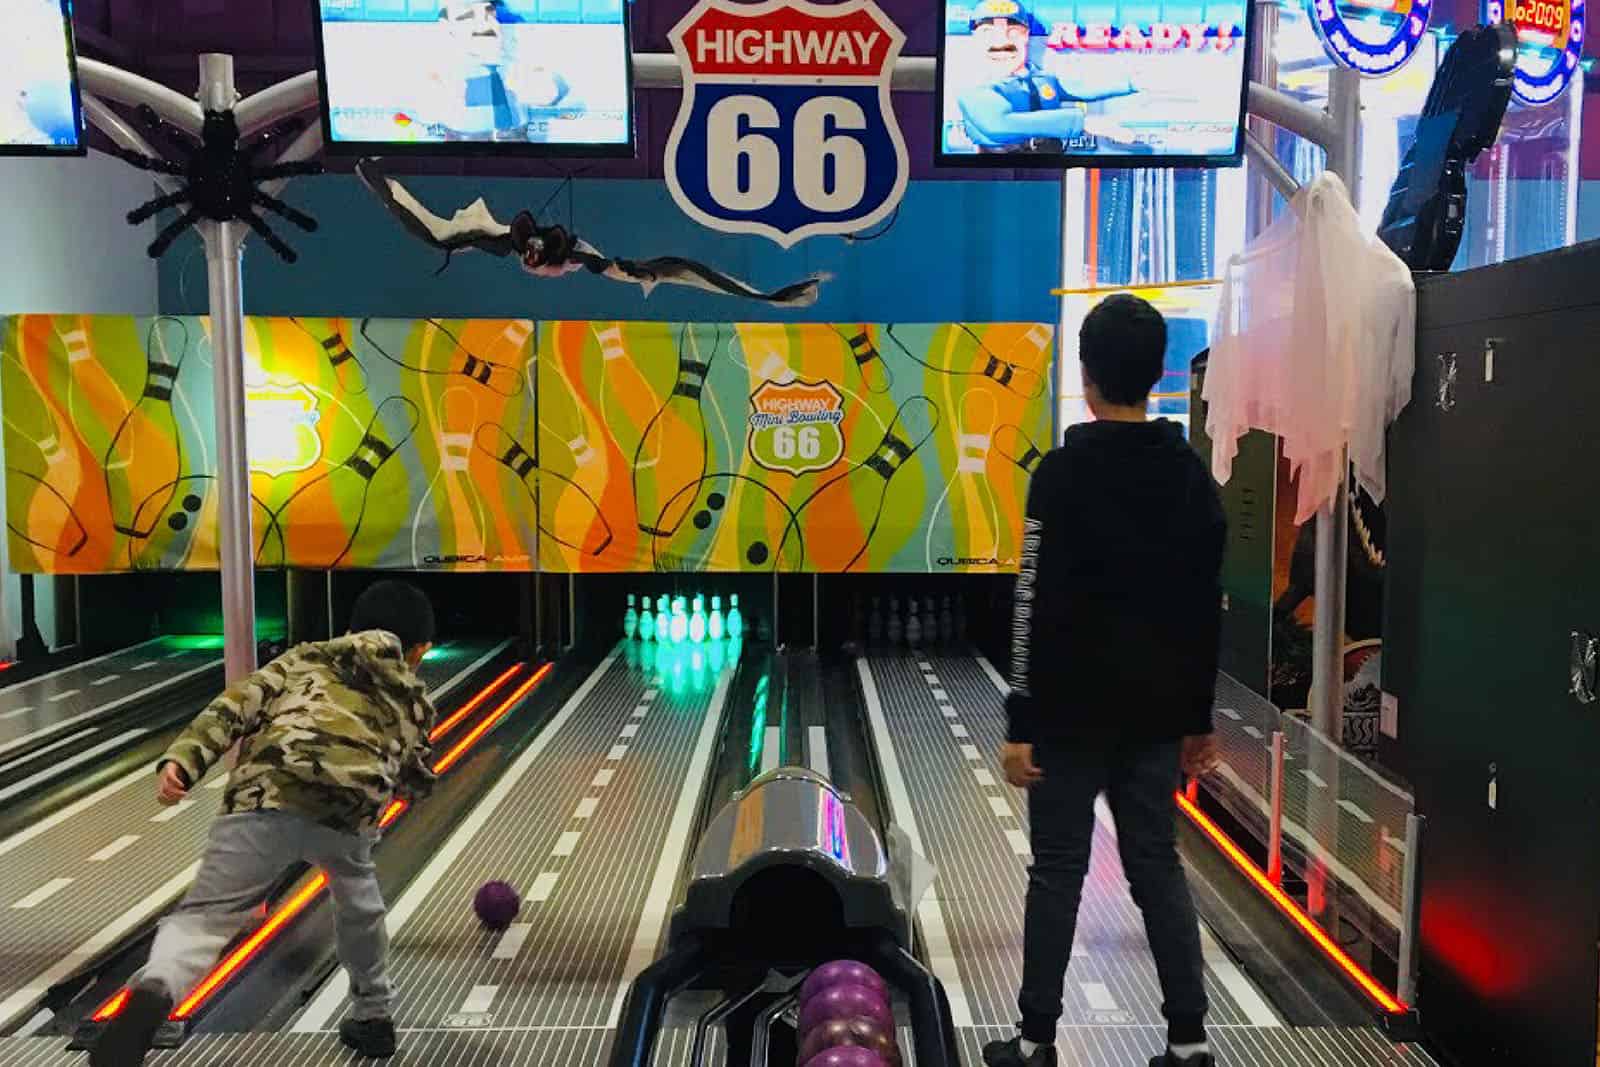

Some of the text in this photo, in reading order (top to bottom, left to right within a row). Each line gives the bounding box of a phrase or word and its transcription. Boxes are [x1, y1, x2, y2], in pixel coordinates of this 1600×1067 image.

[696, 29, 880, 65] HIGHWAY
[707, 94, 867, 213] 66
[752, 410, 841, 428] Mini Bowling
[762, 398, 830, 412] HIGHWAY
[773, 426, 820, 459] 66
